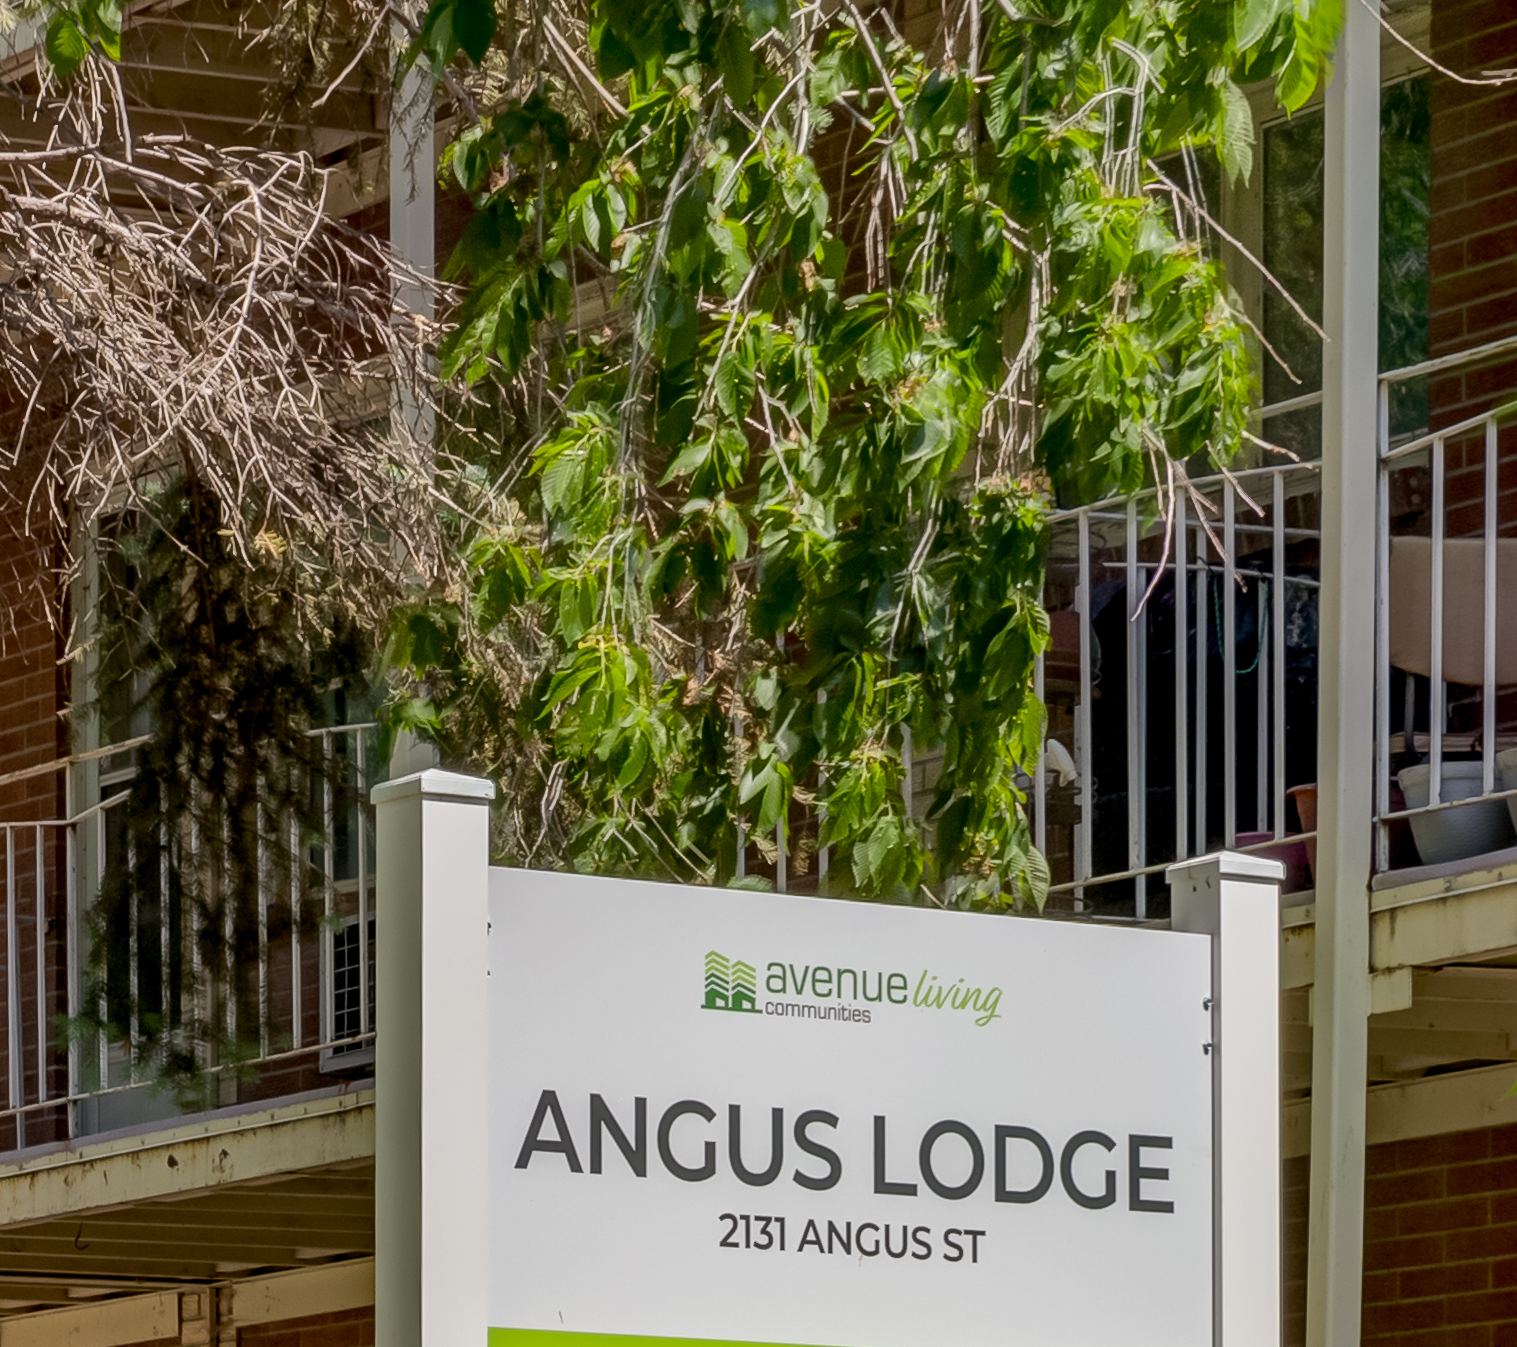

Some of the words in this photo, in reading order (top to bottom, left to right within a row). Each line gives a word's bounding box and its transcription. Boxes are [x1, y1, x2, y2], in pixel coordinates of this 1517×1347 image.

[764, 1000, 872, 1024] communities
[765, 961, 908, 1004] avenue
[912, 969, 1003, 1027] living
[514, 1089, 843, 1192] ANGUS
[873, 1114, 1175, 1214] LODGE
[718, 1212, 786, 1252] 2131
[796, 1218, 933, 1261] ANGUS
[942, 1227, 987, 1264] ST
